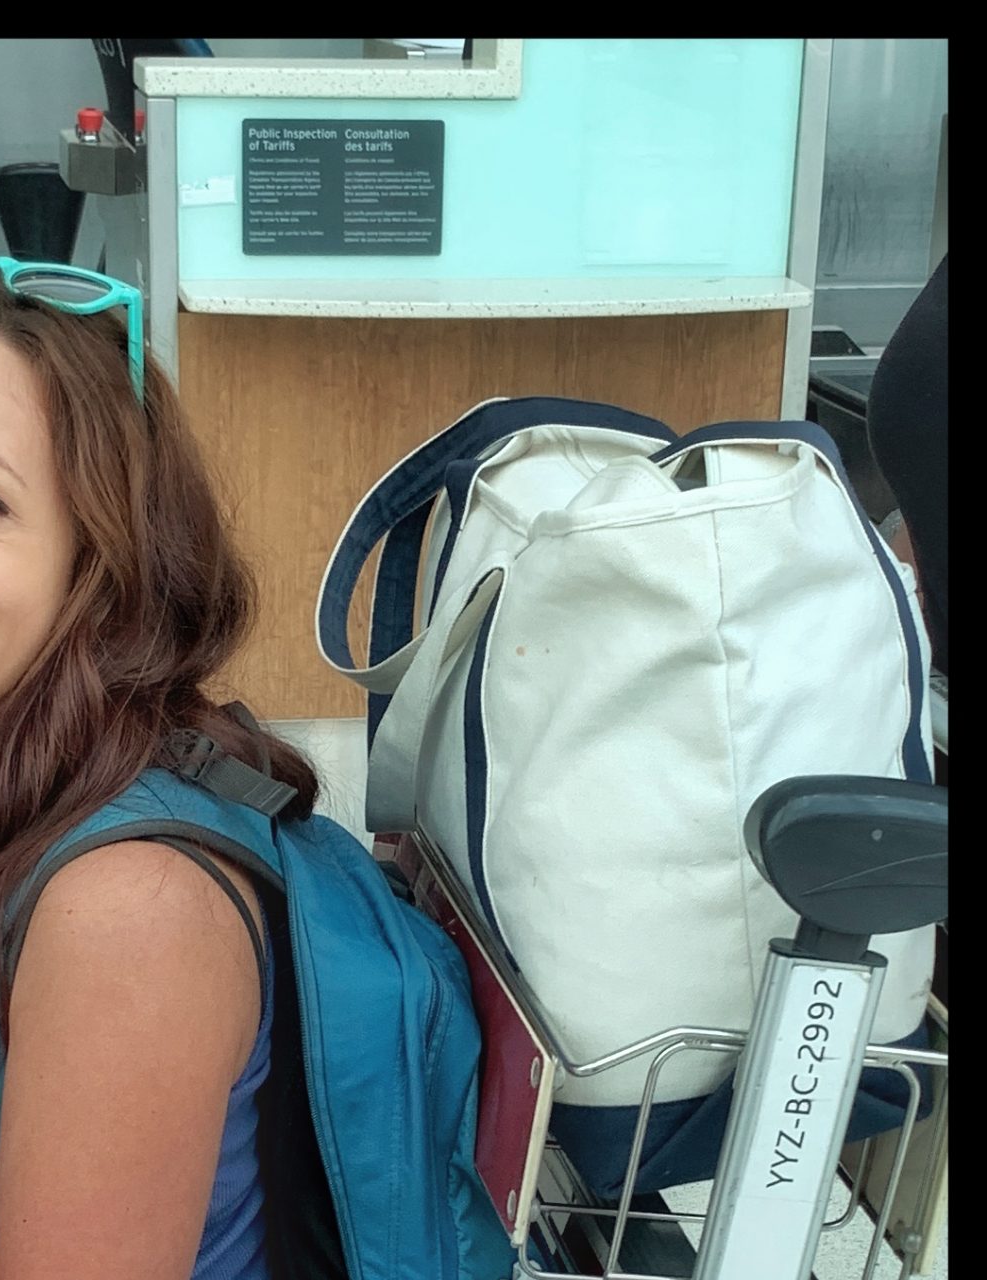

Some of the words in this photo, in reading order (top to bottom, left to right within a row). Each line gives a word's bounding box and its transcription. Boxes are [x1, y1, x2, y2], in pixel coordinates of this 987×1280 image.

[248, 128, 281, 139] Public
[283, 128, 337, 140] Inspection
[344, 128, 410, 140] Consultation
[249, 140, 260, 151] of
[262, 140, 296, 151] Tariffs
[344, 141, 363, 152] des
[365, 141, 394, 152] tarifs
[766, 980, 843, 1188] YYZ-BC-2992
